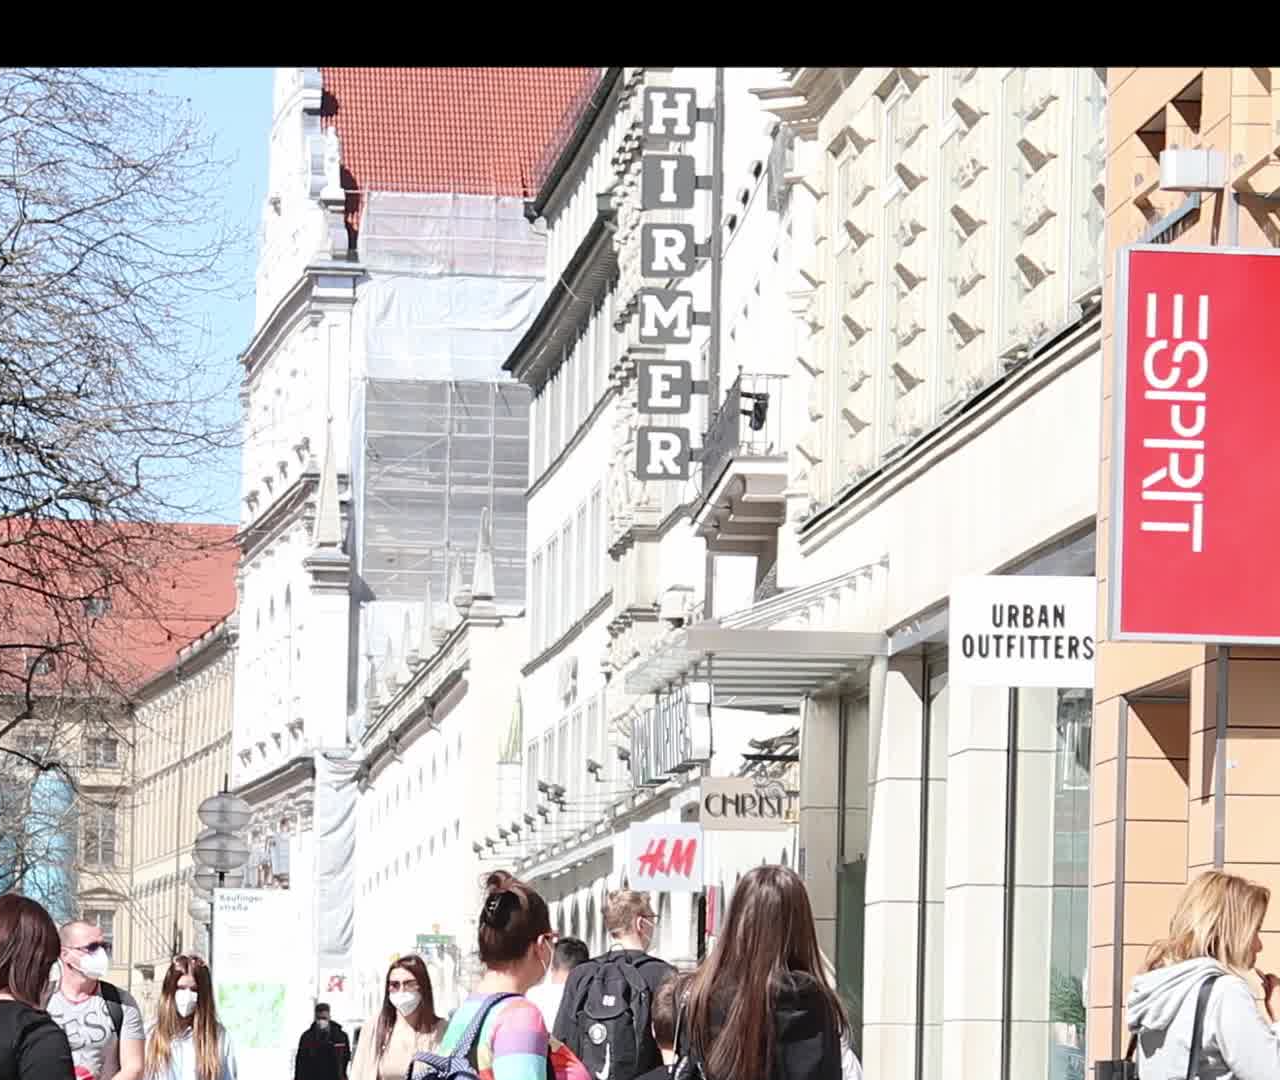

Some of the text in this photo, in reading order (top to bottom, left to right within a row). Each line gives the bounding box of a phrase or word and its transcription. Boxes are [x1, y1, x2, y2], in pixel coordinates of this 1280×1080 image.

[641, 92, 691, 475] HIRMER
[1139, 292, 1209, 553] ESPRIT
[991, 603, 1065, 629] URBAN
[961, 632, 1095, 662] OUTFITTERS
[637, 837, 697, 880] H&M
